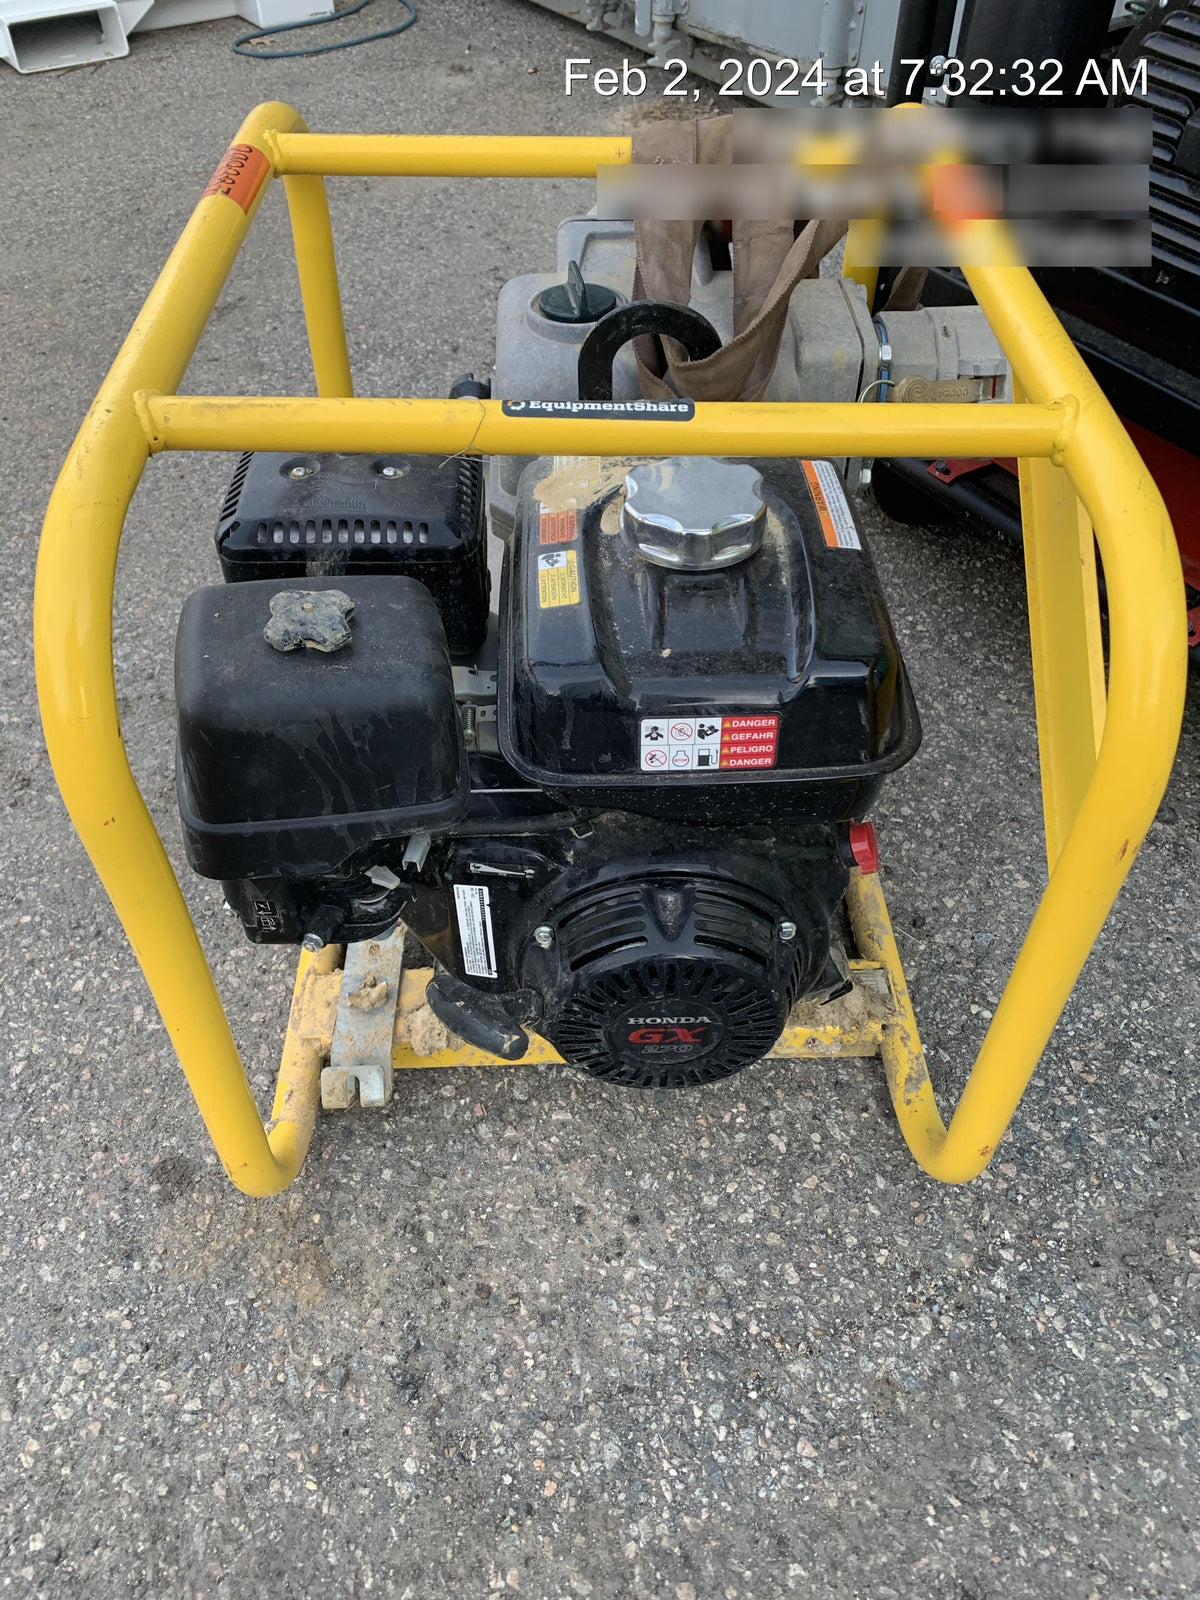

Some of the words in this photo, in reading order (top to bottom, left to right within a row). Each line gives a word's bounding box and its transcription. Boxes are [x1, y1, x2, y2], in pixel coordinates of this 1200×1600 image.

[529, 400, 689, 412] EquipmentShare
[810, 481, 828, 512] WARNING
[568, 565, 578, 593] CAUTION
[731, 719, 776, 729] DANGER
[731, 732, 774, 741] GEFAHR
[730, 744, 773, 754] PELIGRO
[729, 757, 772, 767] DANGER
[627, 1016, 713, 1025] HONDA
[628, 1027, 707, 1043] GX
[641, 1044, 694, 1054] 270
